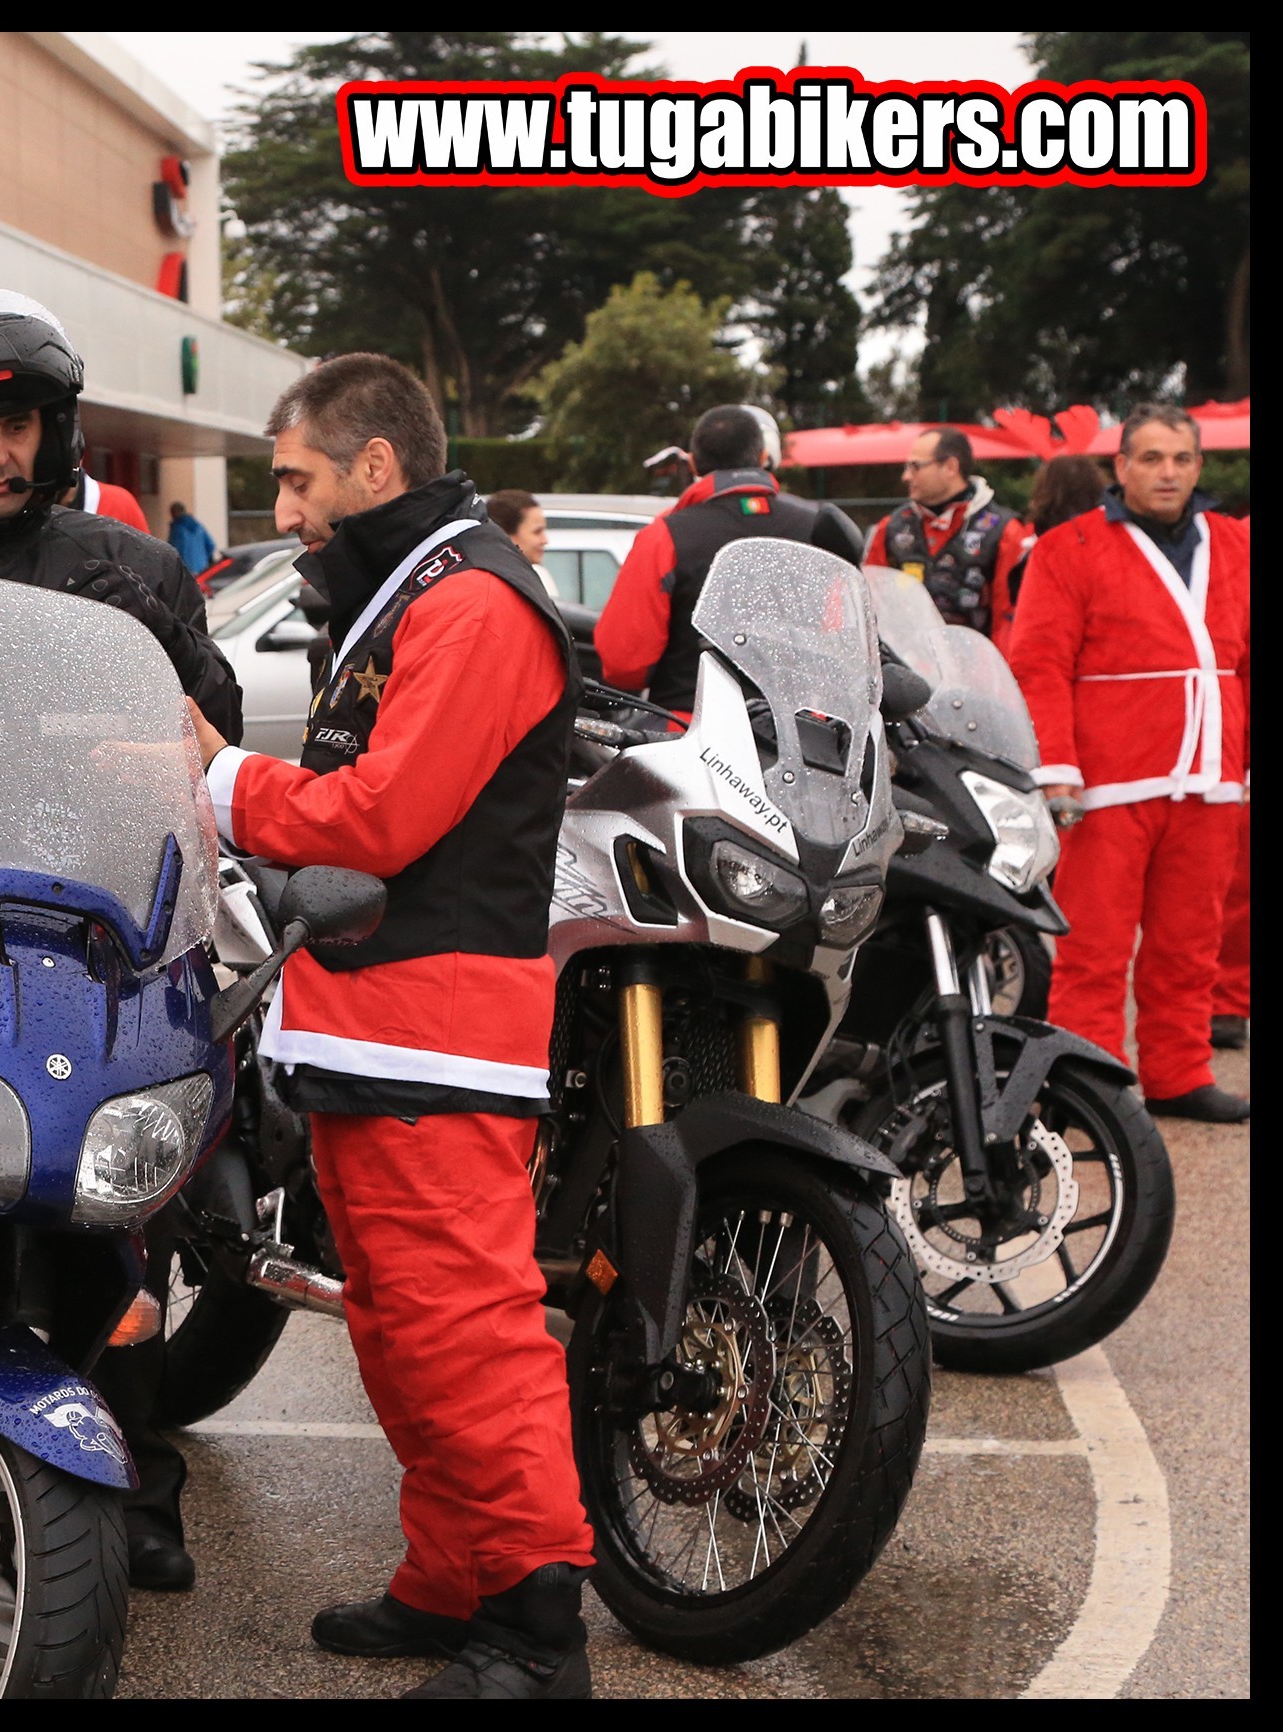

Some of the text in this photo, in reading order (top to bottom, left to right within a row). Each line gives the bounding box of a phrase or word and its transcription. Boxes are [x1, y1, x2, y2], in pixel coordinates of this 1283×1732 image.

[699, 747, 788, 834] Linhaway.pt
[29, 1387, 76, 1415] MOTARDS
[76, 1386, 90, 1396] DO
